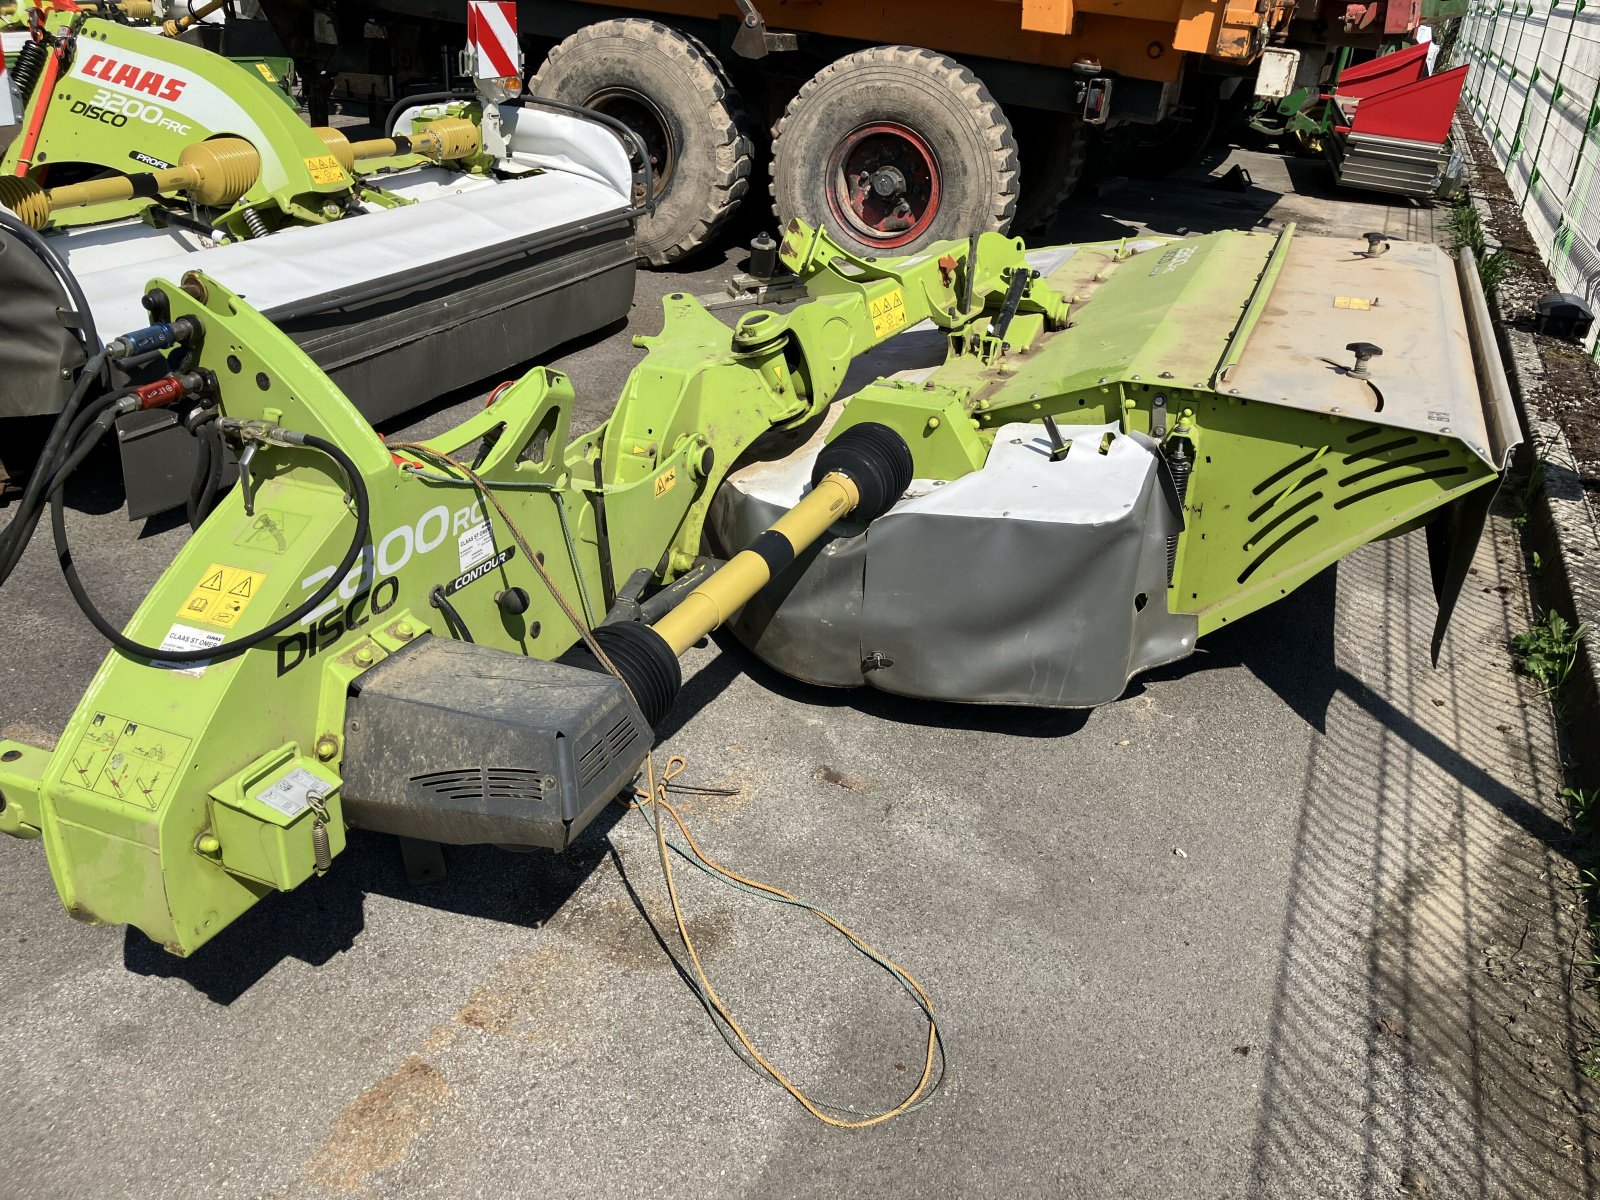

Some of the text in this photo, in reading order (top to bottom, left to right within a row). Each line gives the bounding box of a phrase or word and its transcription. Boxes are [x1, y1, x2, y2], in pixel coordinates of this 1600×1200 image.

[81, 54, 187, 102] CLAAS
[69, 100, 128, 128] DISCO
[136, 153, 168, 170] PROFIL
[454, 552, 506, 590] CONTOUR
[169, 632, 190, 643] CLAAS
[189, 637, 200, 645] ST
[199, 639, 218, 648] OMER
[276, 575, 399, 678] DISCO
